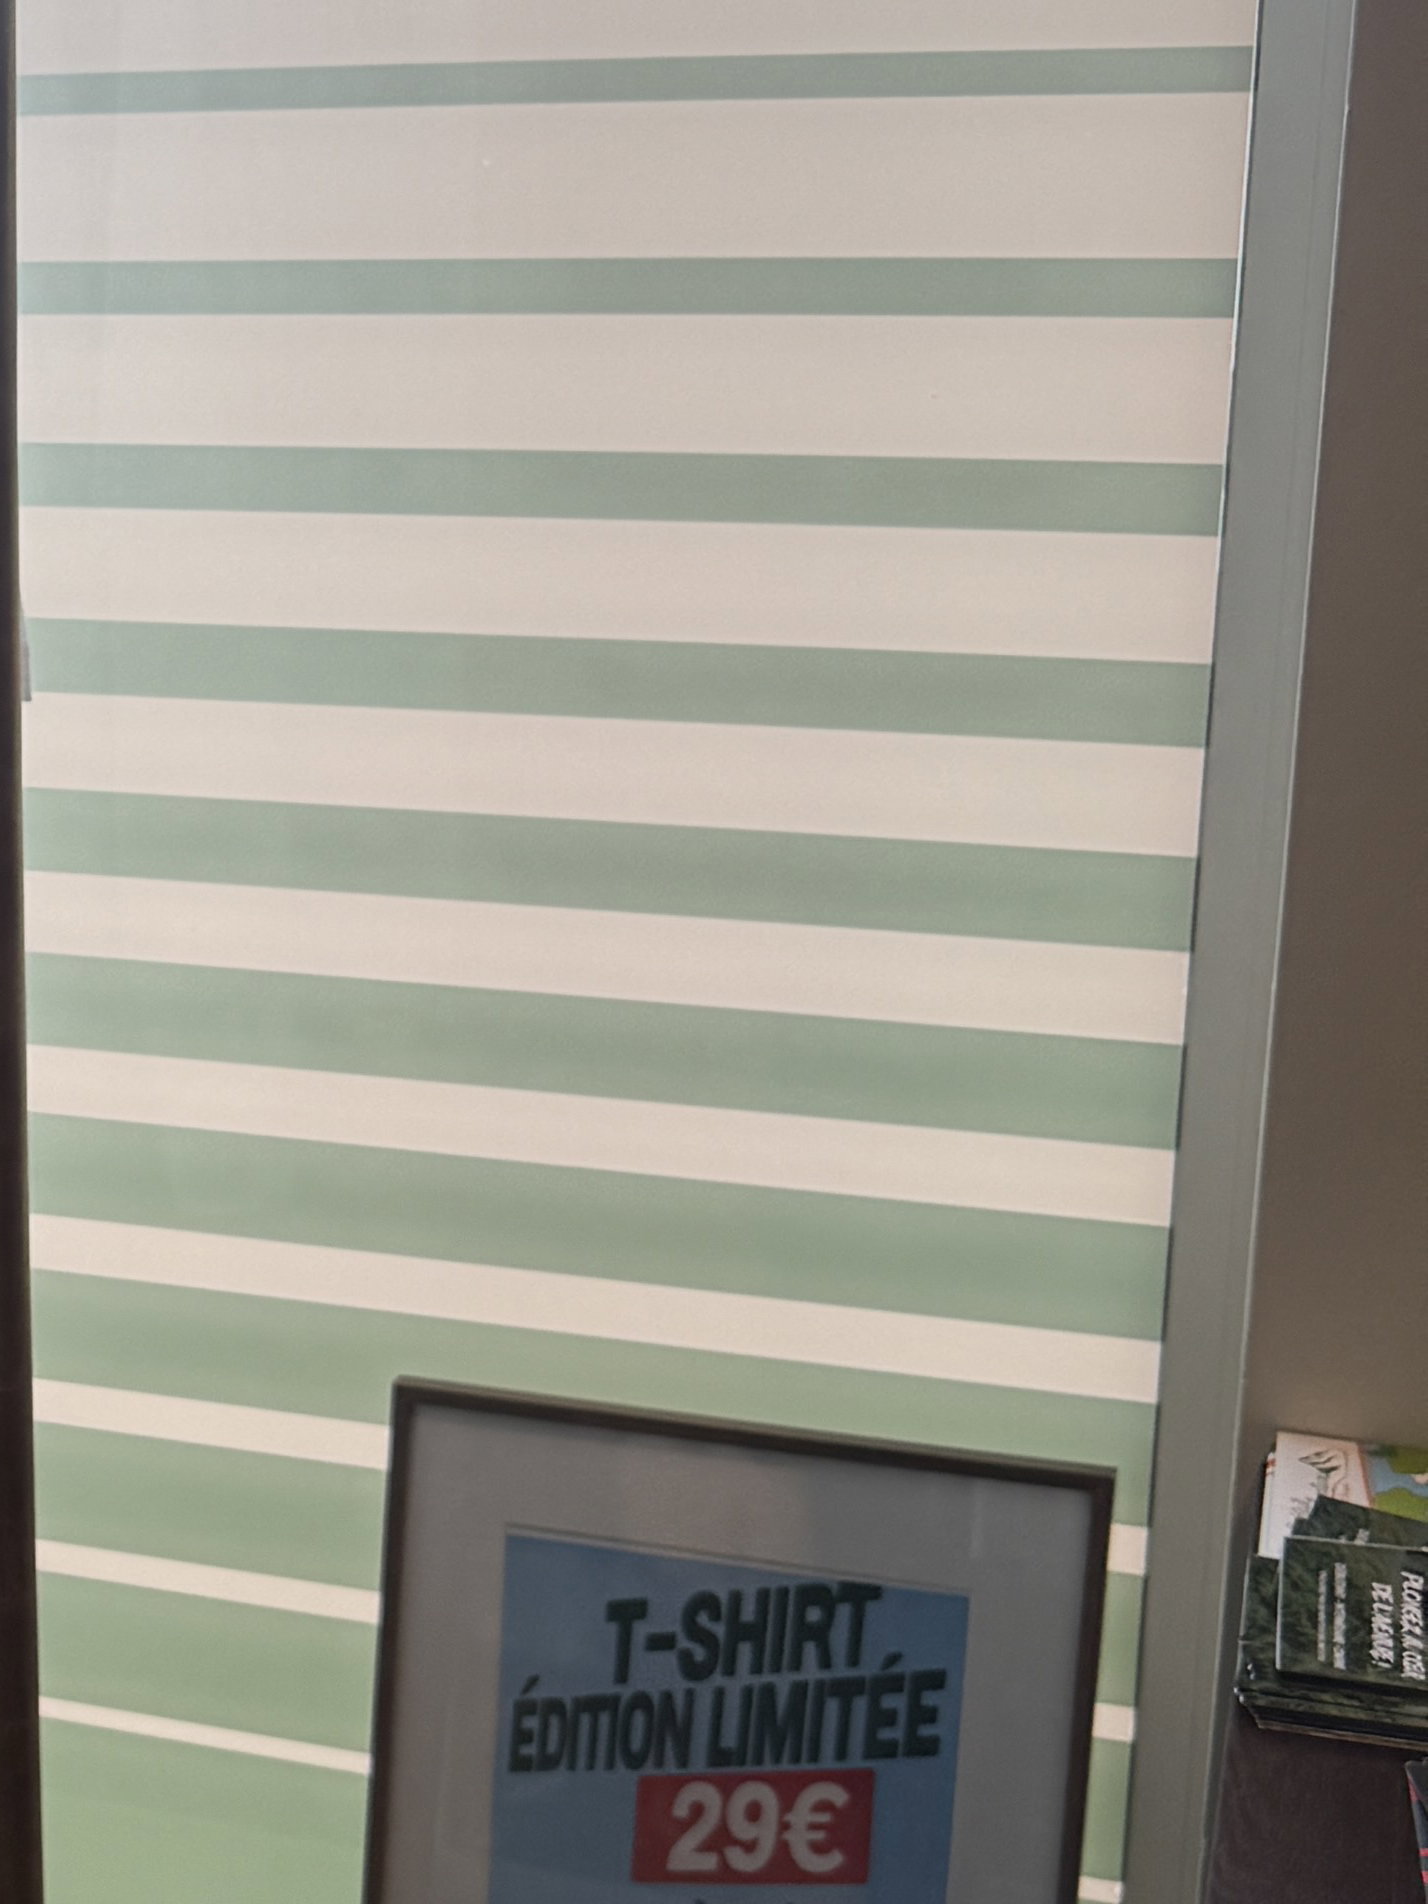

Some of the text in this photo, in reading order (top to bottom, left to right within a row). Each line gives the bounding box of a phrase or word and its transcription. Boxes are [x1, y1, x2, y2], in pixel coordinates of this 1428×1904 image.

[605, 1580, 883, 1685] T-SHIRT
[508, 1651, 948, 1773] ÉDITION LIMITÉE
[665, 1779, 852, 1874] 29€
